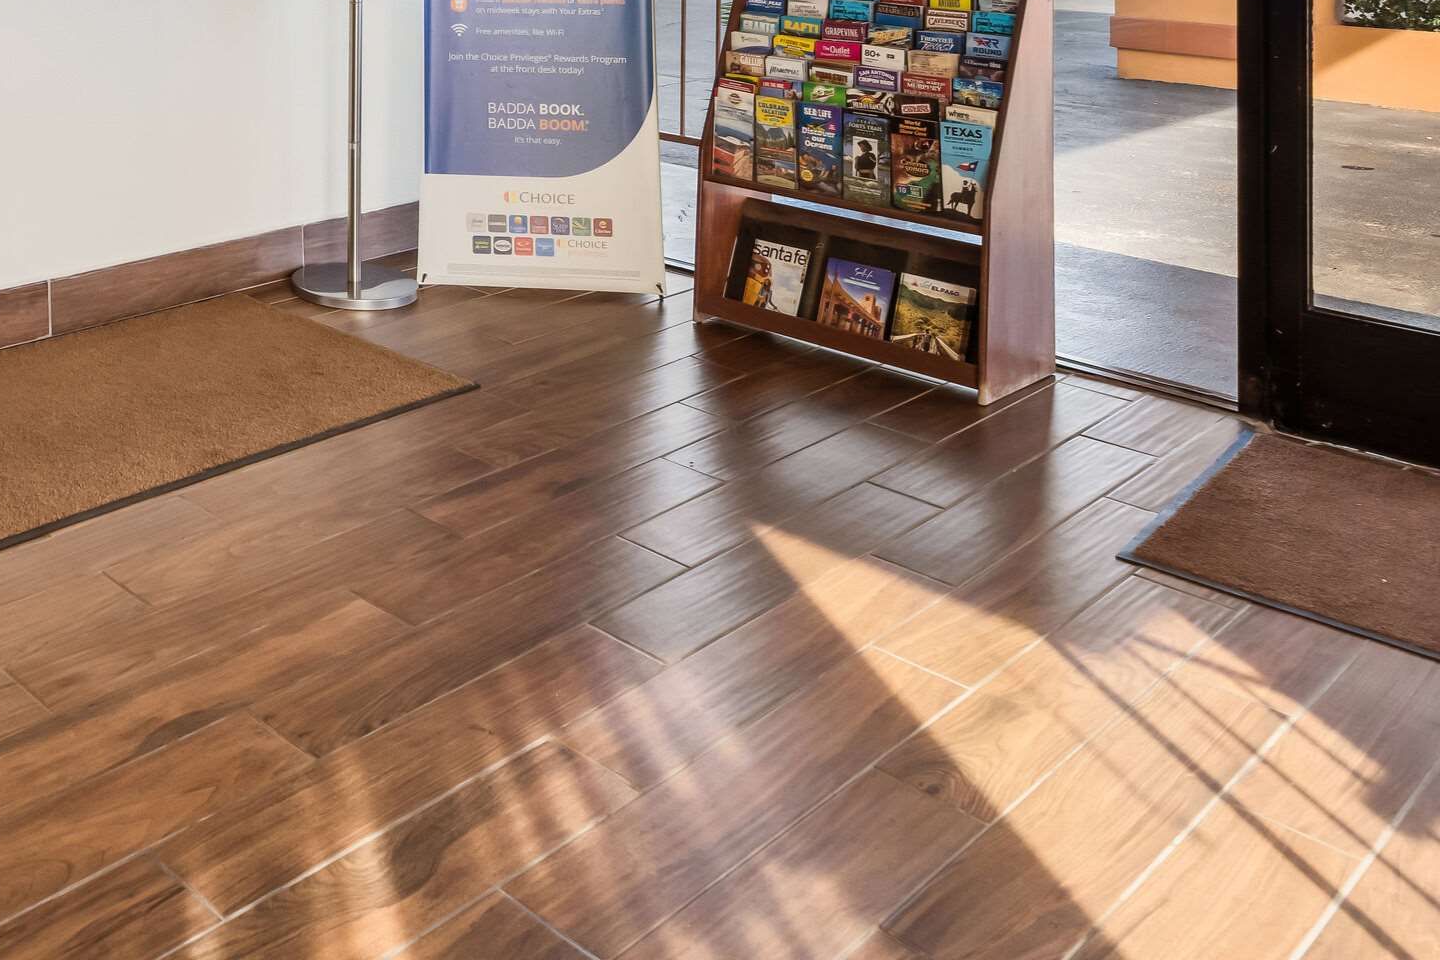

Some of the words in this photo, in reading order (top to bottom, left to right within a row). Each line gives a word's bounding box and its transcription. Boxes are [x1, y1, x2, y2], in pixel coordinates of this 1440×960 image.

[825, 27, 858, 37] GRAPEVINE
[830, 45, 850, 54] Outlet
[864, 49, 881, 57] 80+
[448, 52, 463, 61] Join
[465, 53, 479, 61] the
[481, 53, 508, 61] Choice
[554, 54, 589, 63] Rewards
[591, 55, 627, 65] Program
[537, 66, 556, 74] desk
[871, 70, 895, 81] ANTONIO
[488, 102, 536, 114] BADDA
[539, 103, 584, 116] BOOK.
[818, 109, 832, 118] LIFE
[948, 110, 970, 120] where
[488, 118, 536, 129] BADDA
[801, 127, 835, 138] Discover
[944, 126, 983, 139] TEXAS
[526, 136, 542, 144] that
[543, 137, 562, 146] easy.
[520, 191, 576, 205] CHOICE
[567, 239, 608, 249] CHOICE
